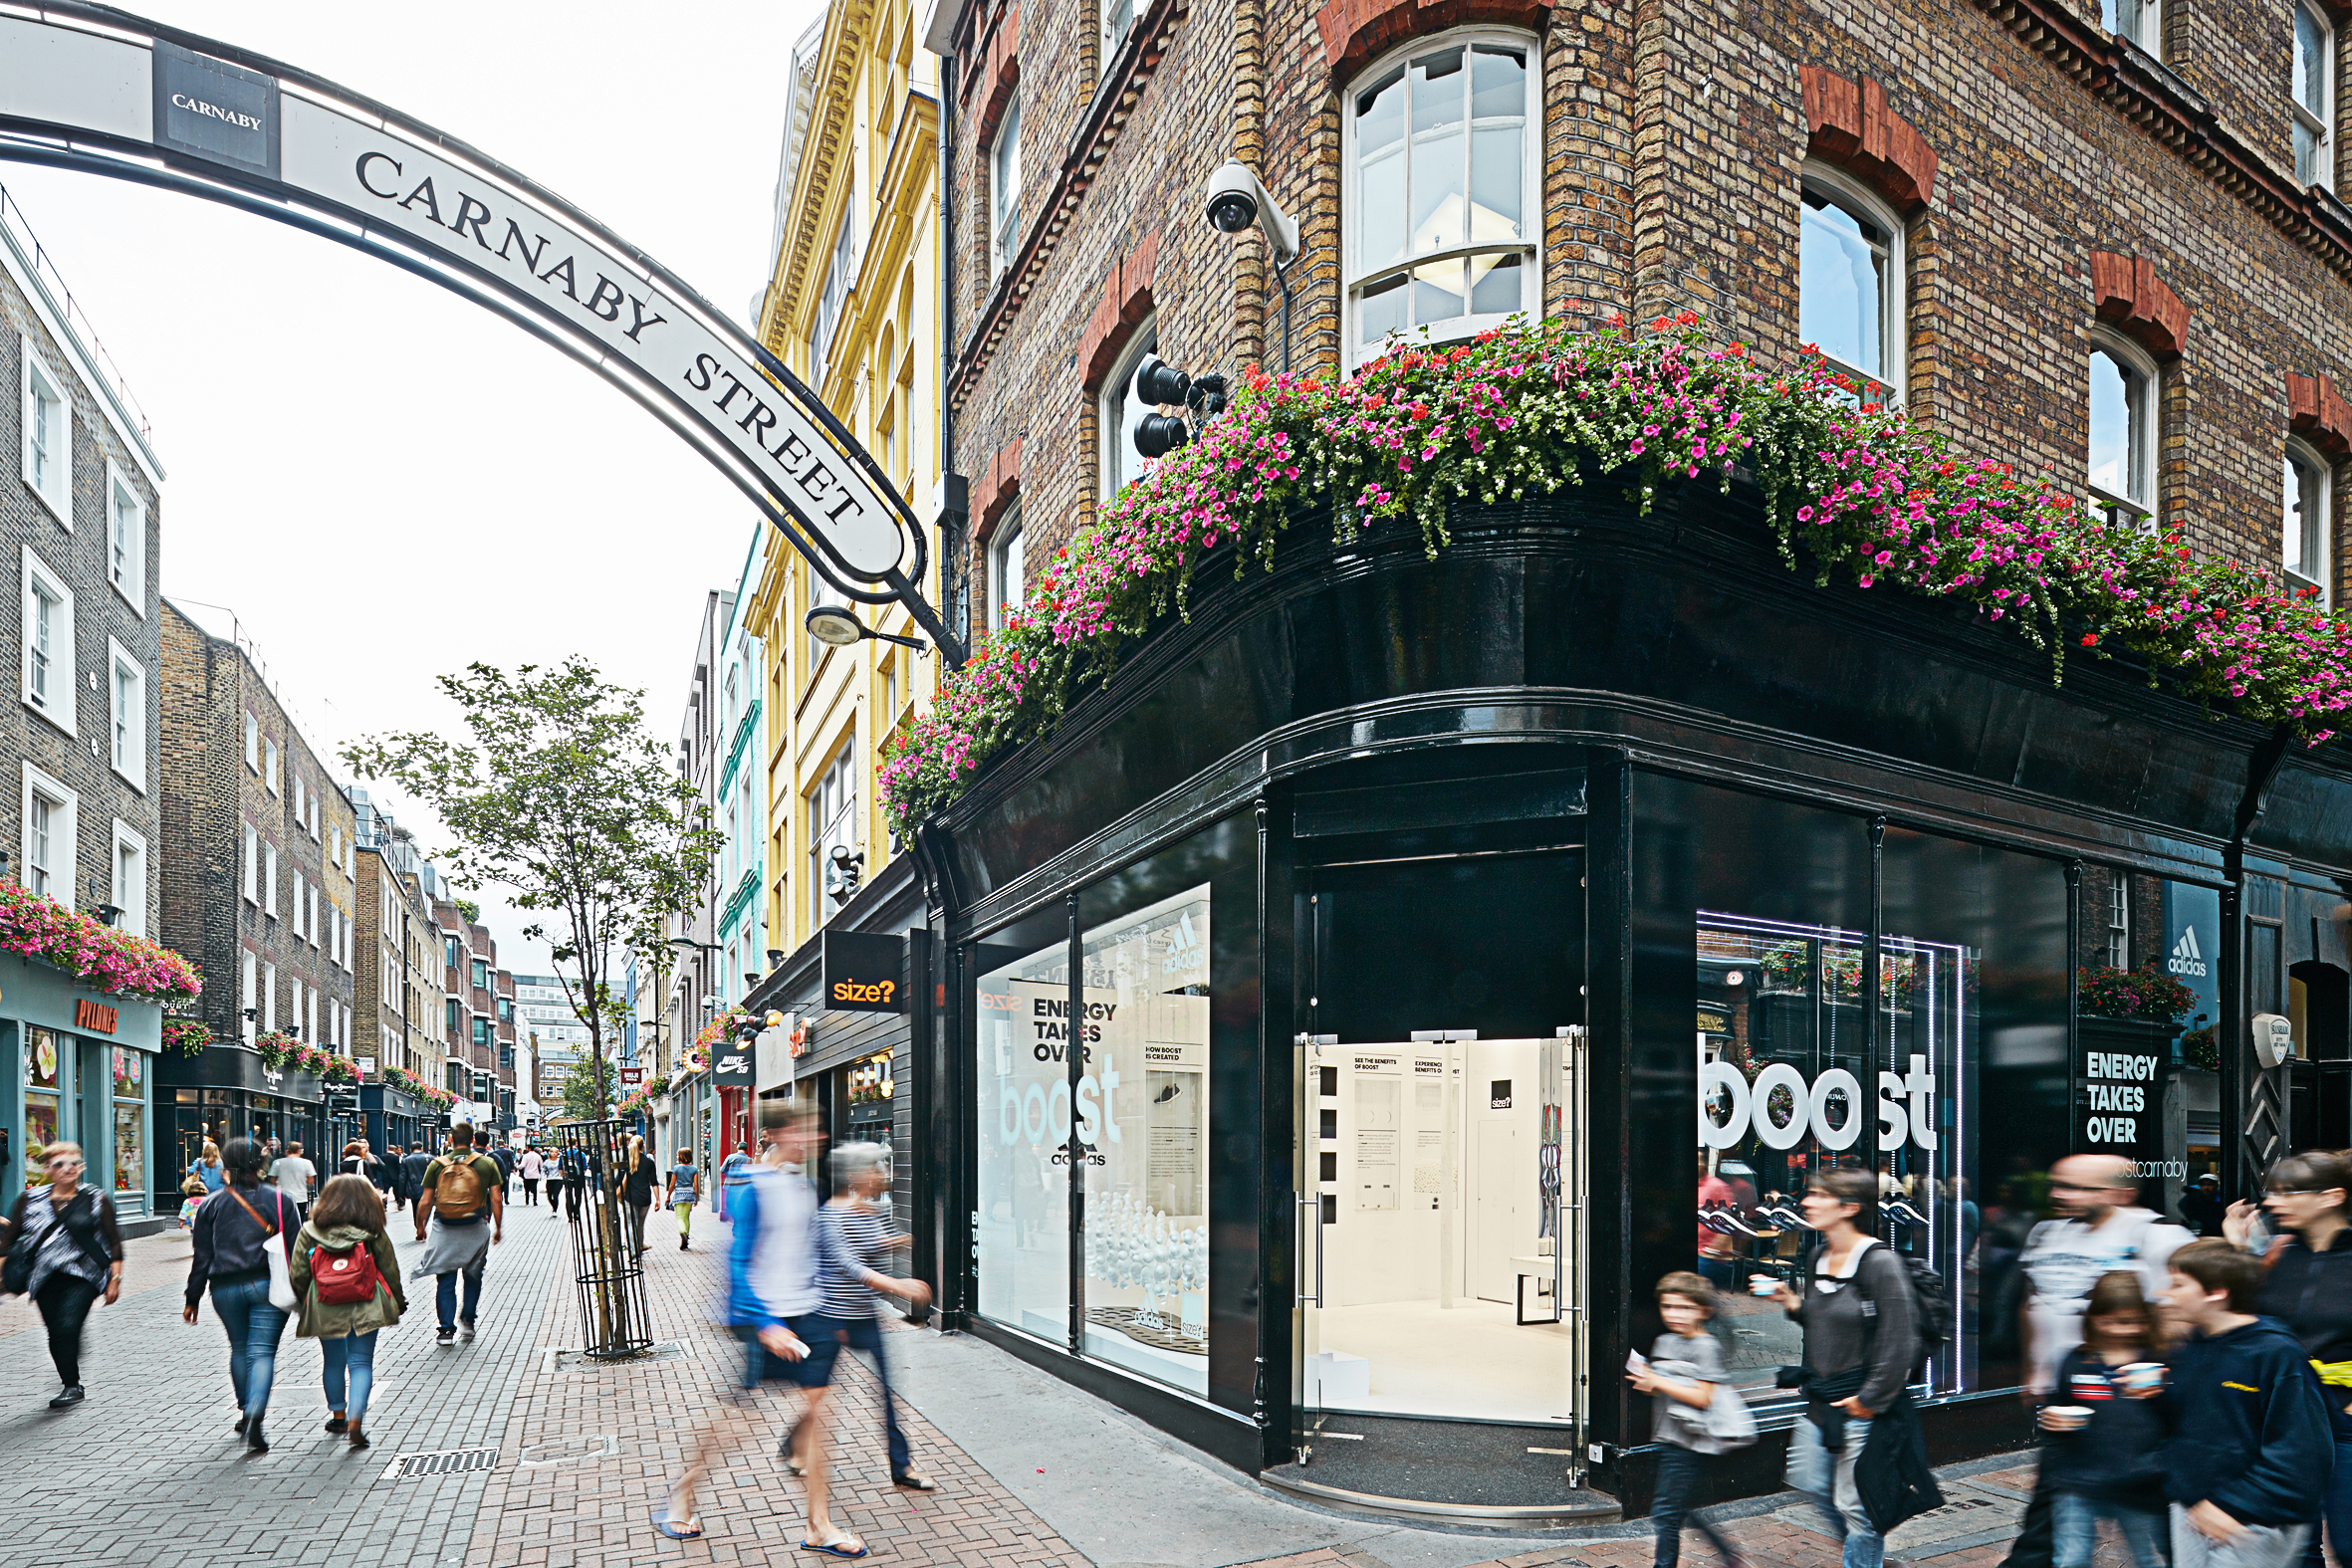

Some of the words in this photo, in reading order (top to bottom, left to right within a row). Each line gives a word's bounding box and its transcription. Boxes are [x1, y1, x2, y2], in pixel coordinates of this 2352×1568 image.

[171, 94, 262, 131] CARNABY
[355, 151, 668, 344] CARNABY
[683, 352, 864, 526] STREET
[1161, 948, 1204, 975] adidas
[2168, 956, 2207, 977] adidas
[833, 978, 895, 1004] size?
[77, 999, 118, 1034] PYLONES
[721, 1055, 746, 1065] NIKE
[1034, 1043, 1092, 1064] OVR
[2087, 1051, 2158, 1081] ENERGY
[736, 1065, 750, 1074] SB
[1000, 1052, 1121, 1146] boost
[1492, 1096, 1512, 1108] size?
[1697, 1032, 1937, 1151] boost
[2087, 1084, 2145, 1112] TAKES
[2086, 1116, 2137, 1143] OVER
[1051, 1151, 1106, 1166] aas
[2115, 1156, 2188, 1182] ostcarnaby
[1135, 1310, 1164, 1330] adidas
[1182, 1320, 1202, 1337] size?
